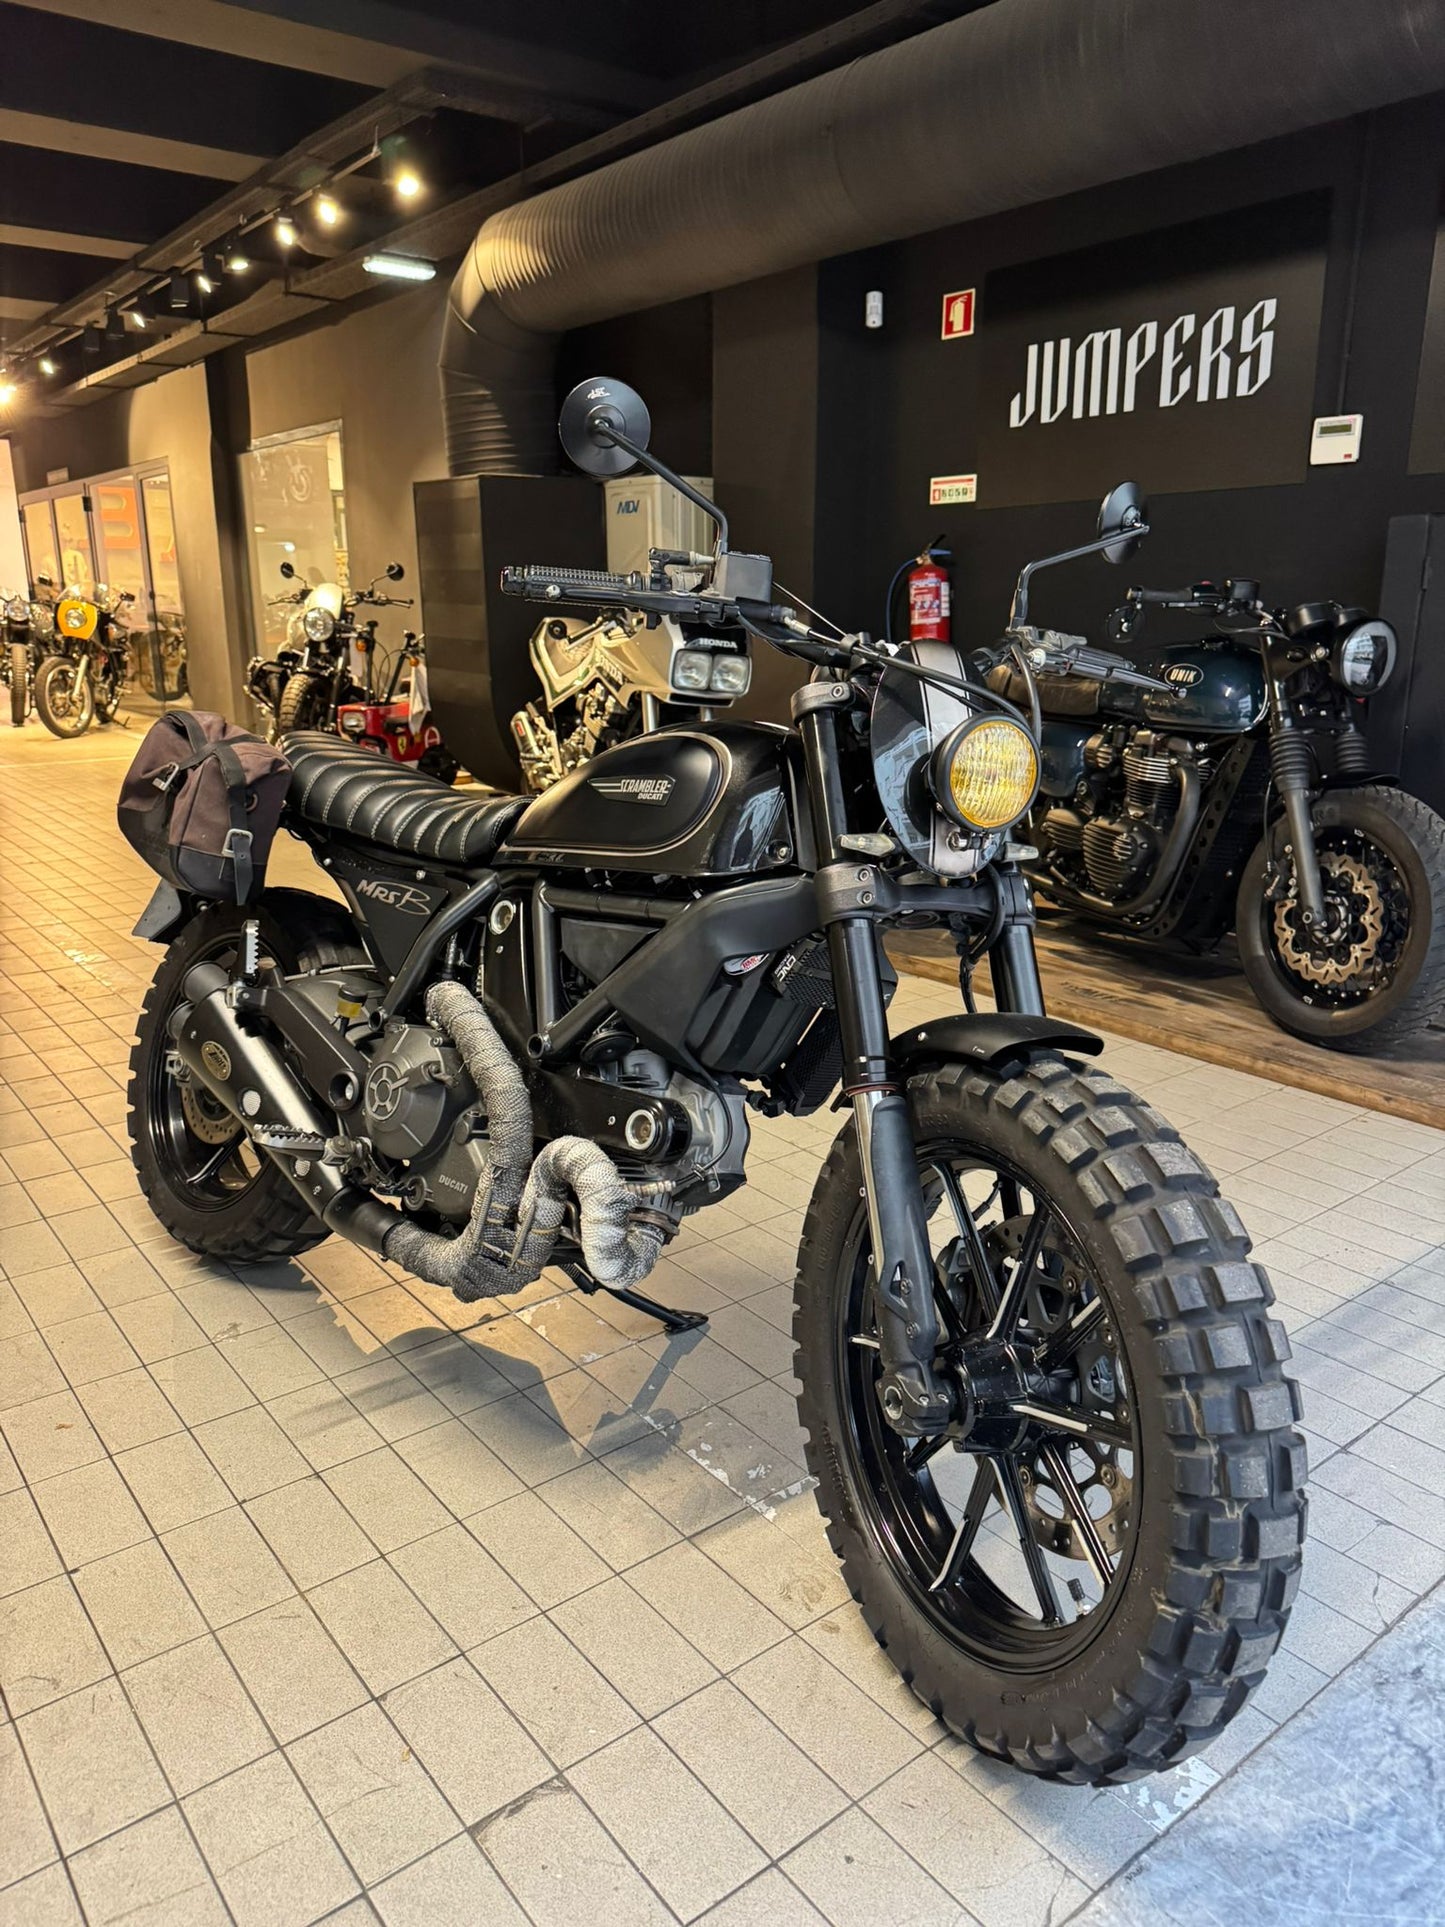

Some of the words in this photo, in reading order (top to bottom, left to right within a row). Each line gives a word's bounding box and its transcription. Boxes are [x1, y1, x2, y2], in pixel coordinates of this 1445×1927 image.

[1009, 298, 1277, 428] JUMPERS
[699, 637, 738, 649] HONDA
[1170, 668, 1197, 683] UNIK
[620, 779, 669, 794] SCRAMBLER
[637, 792, 664, 801] DUCATI
[777, 955, 797, 982] CNC
[438, 1174, 469, 1194] DUCATI
